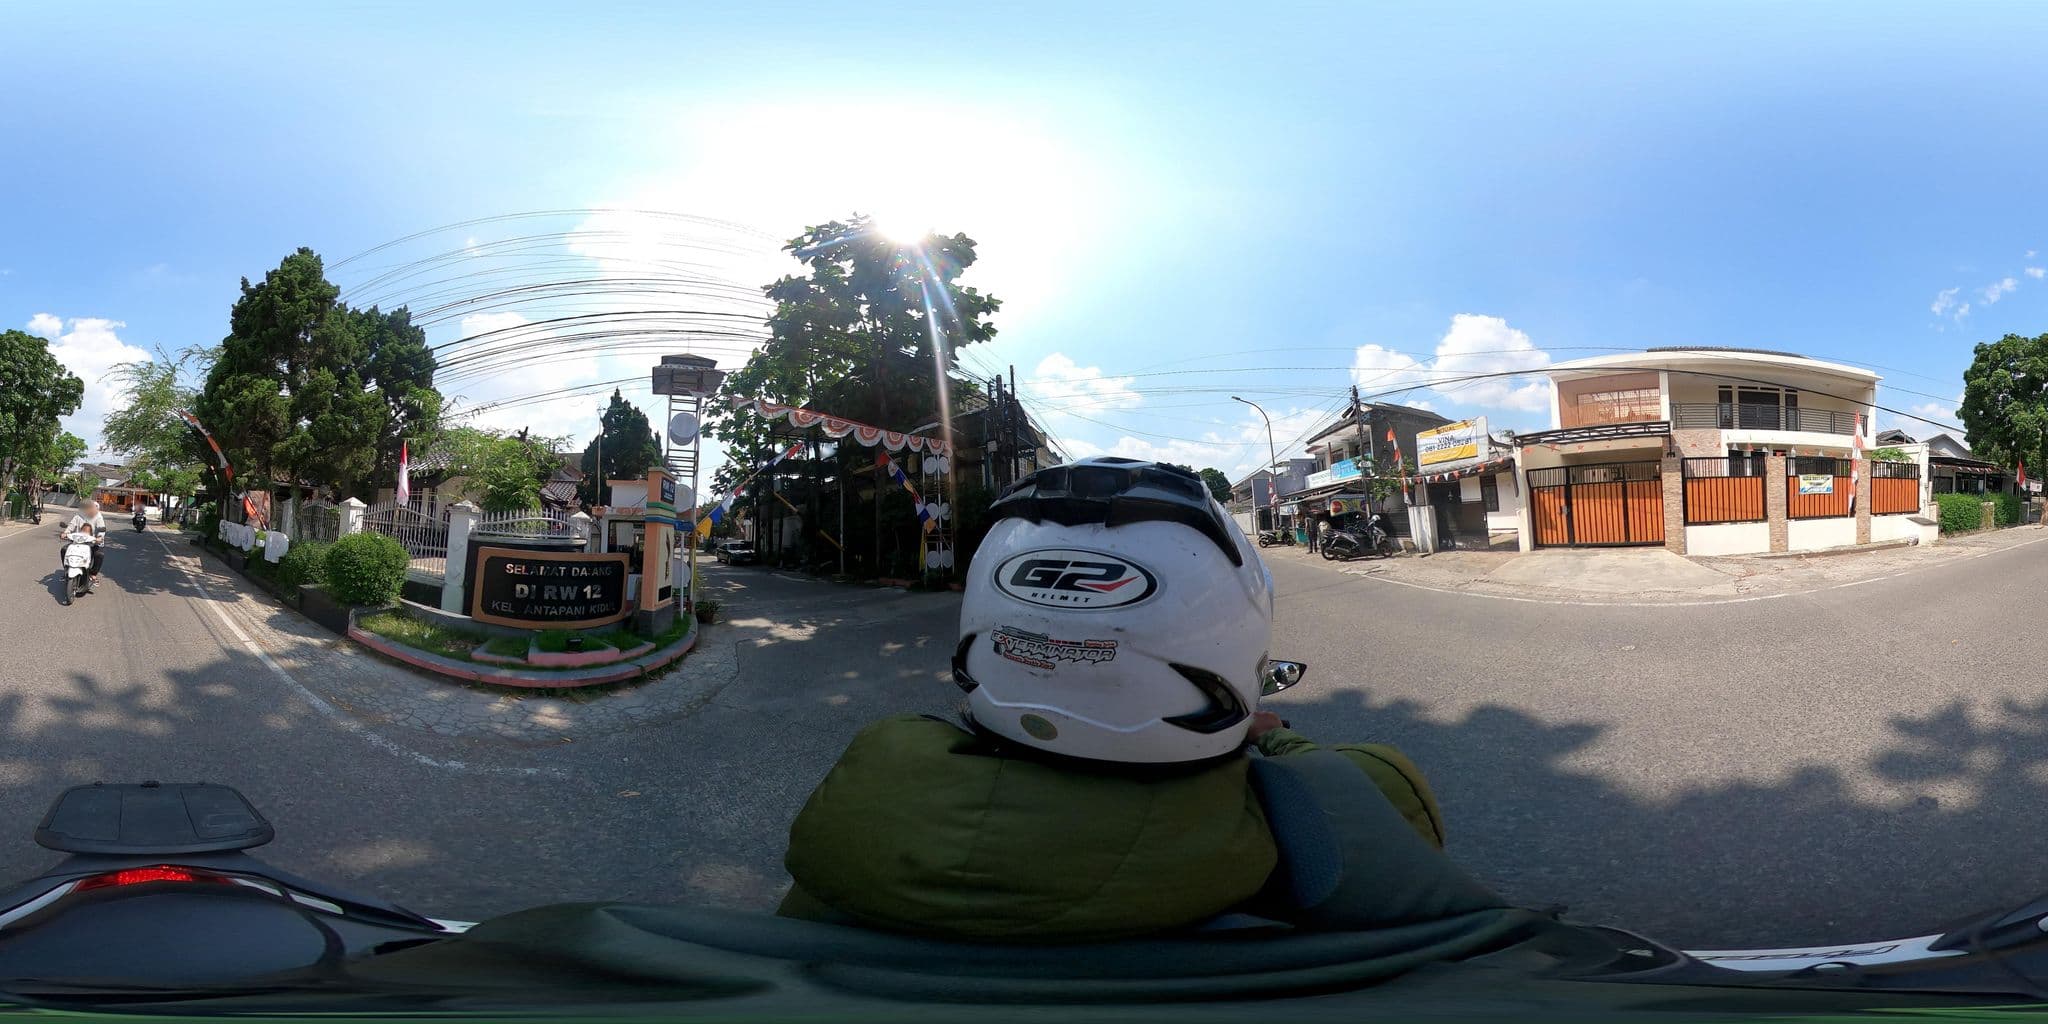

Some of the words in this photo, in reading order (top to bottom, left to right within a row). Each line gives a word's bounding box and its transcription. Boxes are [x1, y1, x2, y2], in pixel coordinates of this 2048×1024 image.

[505, 563, 567, 577] SELAMAT
[1010, 559, 1128, 594] G2
[515, 583, 536, 599] DI
[543, 584, 578, 600] RW
[583, 584, 602, 600] 12
[1031, 592, 1091, 603] HELMET
[525, 604, 585, 616] ANTAPANI
